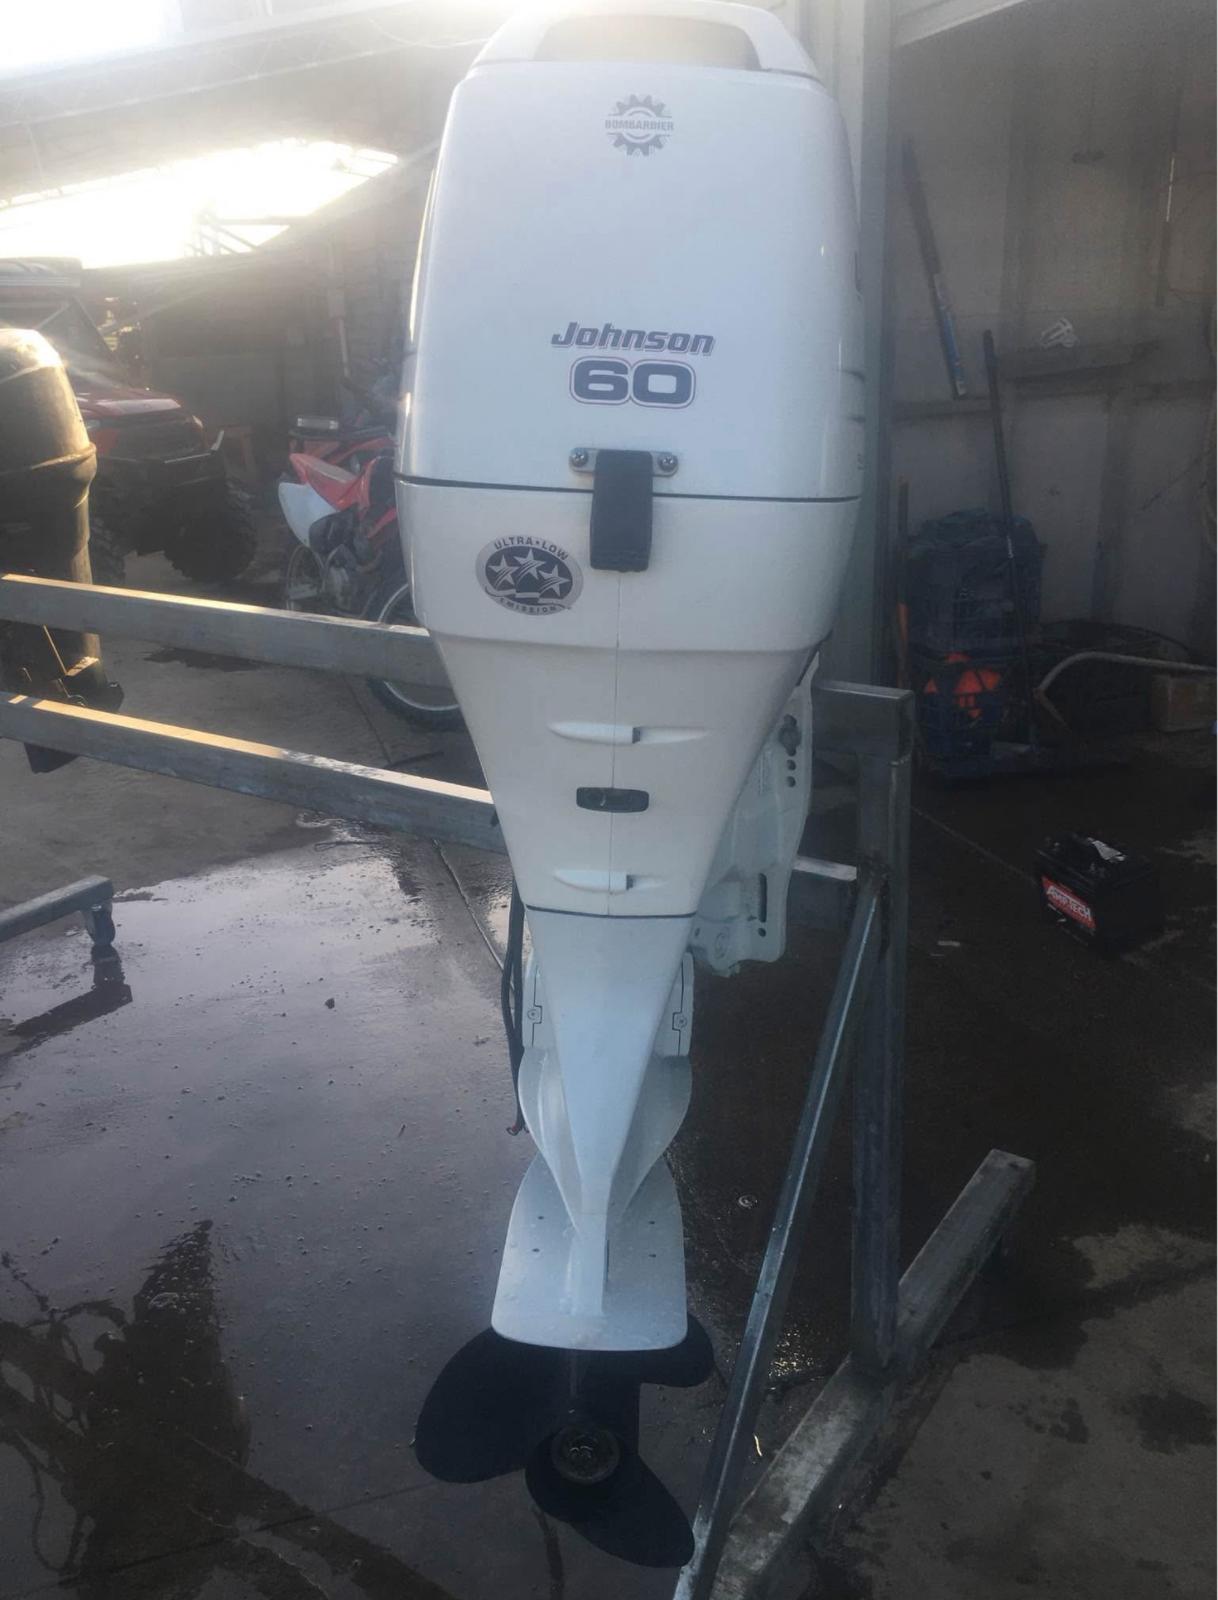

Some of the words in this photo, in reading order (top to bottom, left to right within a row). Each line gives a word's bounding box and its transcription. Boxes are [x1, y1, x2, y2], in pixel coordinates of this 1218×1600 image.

[604, 119, 674, 131] BOMBARDIER
[551, 321, 716, 356] Johnson
[570, 357, 695, 408] 60
